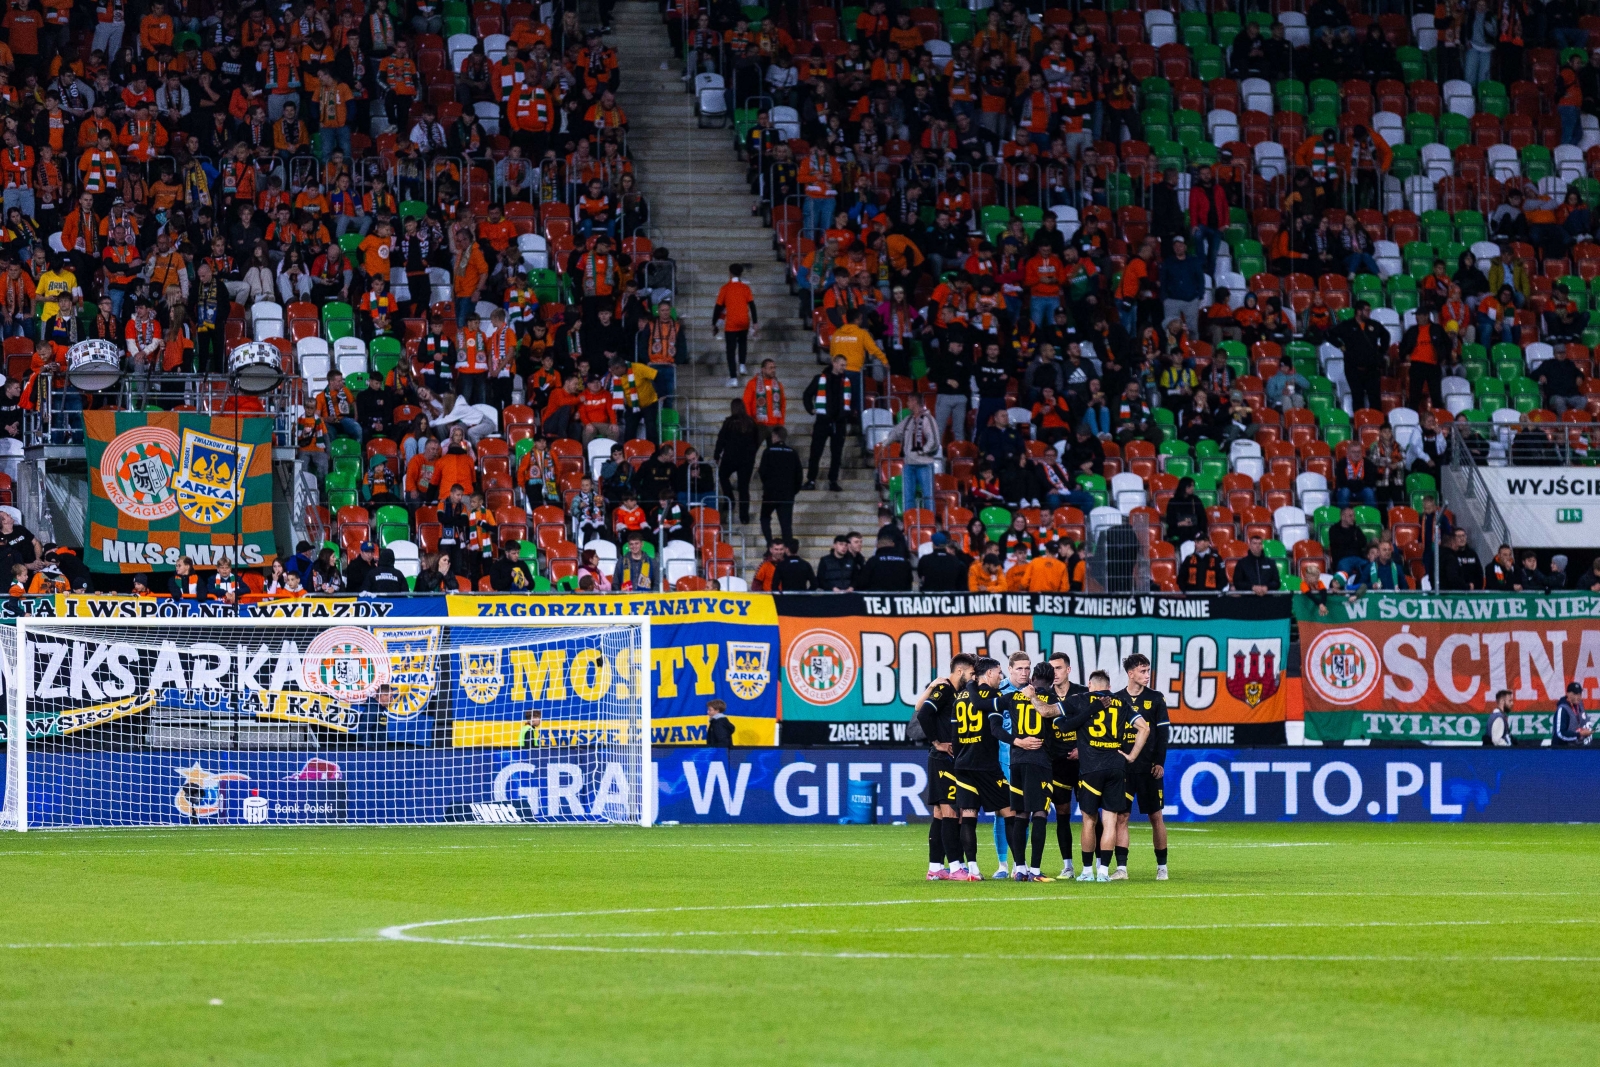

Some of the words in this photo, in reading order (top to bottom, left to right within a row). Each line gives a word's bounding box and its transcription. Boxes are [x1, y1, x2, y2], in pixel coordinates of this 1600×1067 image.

[48, 281, 68, 291] ARKA
[105, 481, 125, 505] MKS
[181, 480, 234, 500] ARKA
[66, 600, 78, 618] I
[477, 603, 623, 617] ZAGORZALI
[629, 597, 751, 616] FANATYCY
[863, 596, 892, 615] TEJ
[893, 595, 966, 615] TRADYCJI
[968, 594, 1003, 613] NIKT
[1006, 595, 1032, 613] NIE
[1035, 595, 1071, 614] JEST
[1140, 597, 1155, 615] W
[1158, 599, 1211, 618] STANIE
[1343, 598, 1369, 619] W
[1378, 595, 1527, 619] ŚCINAWIE
[149, 639, 307, 690] ARKA
[510, 644, 719, 702] MOSTY
[465, 676, 498, 684] ARKA
[732, 672, 764, 681] ARKA
[956, 701, 983, 734] 99
[1016, 703, 1042, 735] 10
[1088, 708, 1118, 739] 31
[1363, 713, 1481, 736] TYLKO
[828, 722, 890, 745] ZAGŁĘBIE
[893, 723, 906, 741] W
[682, 761, 750, 816] W
[274, 802, 300, 814] Bank
[303, 801, 333, 814] Polski
